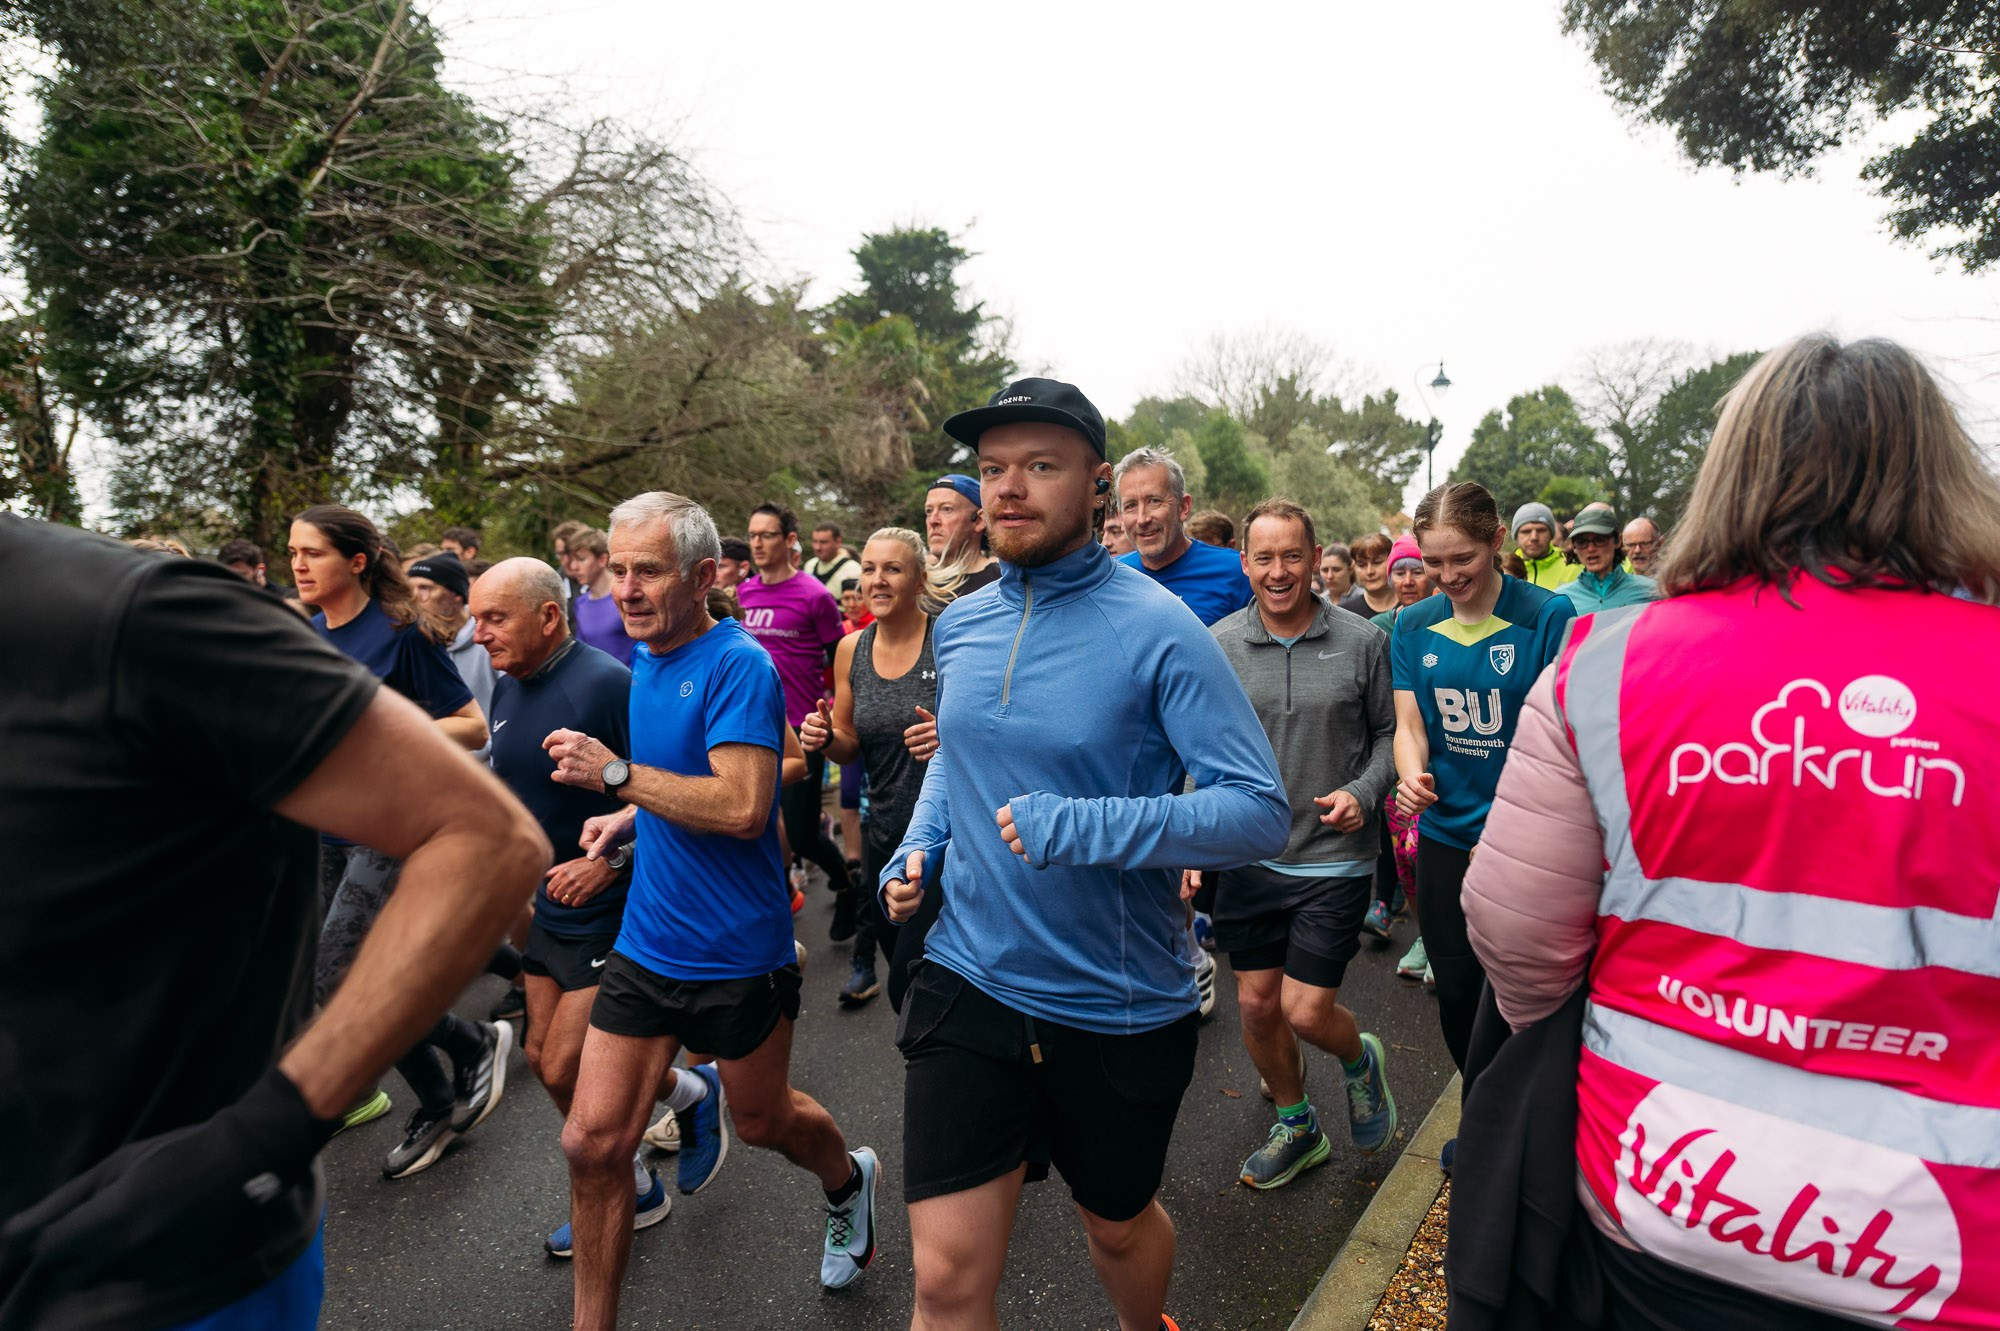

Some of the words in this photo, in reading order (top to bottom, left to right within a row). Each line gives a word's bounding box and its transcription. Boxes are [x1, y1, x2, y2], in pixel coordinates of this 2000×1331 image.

[748, 627, 800, 638] ournemouth
[1434, 687, 1503, 736] BU
[1845, 689, 1911, 721] Vitality
[1444, 733, 1505, 748] Bournemouth
[1446, 743, 1490, 759] University
[1666, 678, 1966, 808] parkrun
[1657, 974, 1950, 1062] VOLUNTEER
[1628, 1122, 1942, 1315] Vitality
